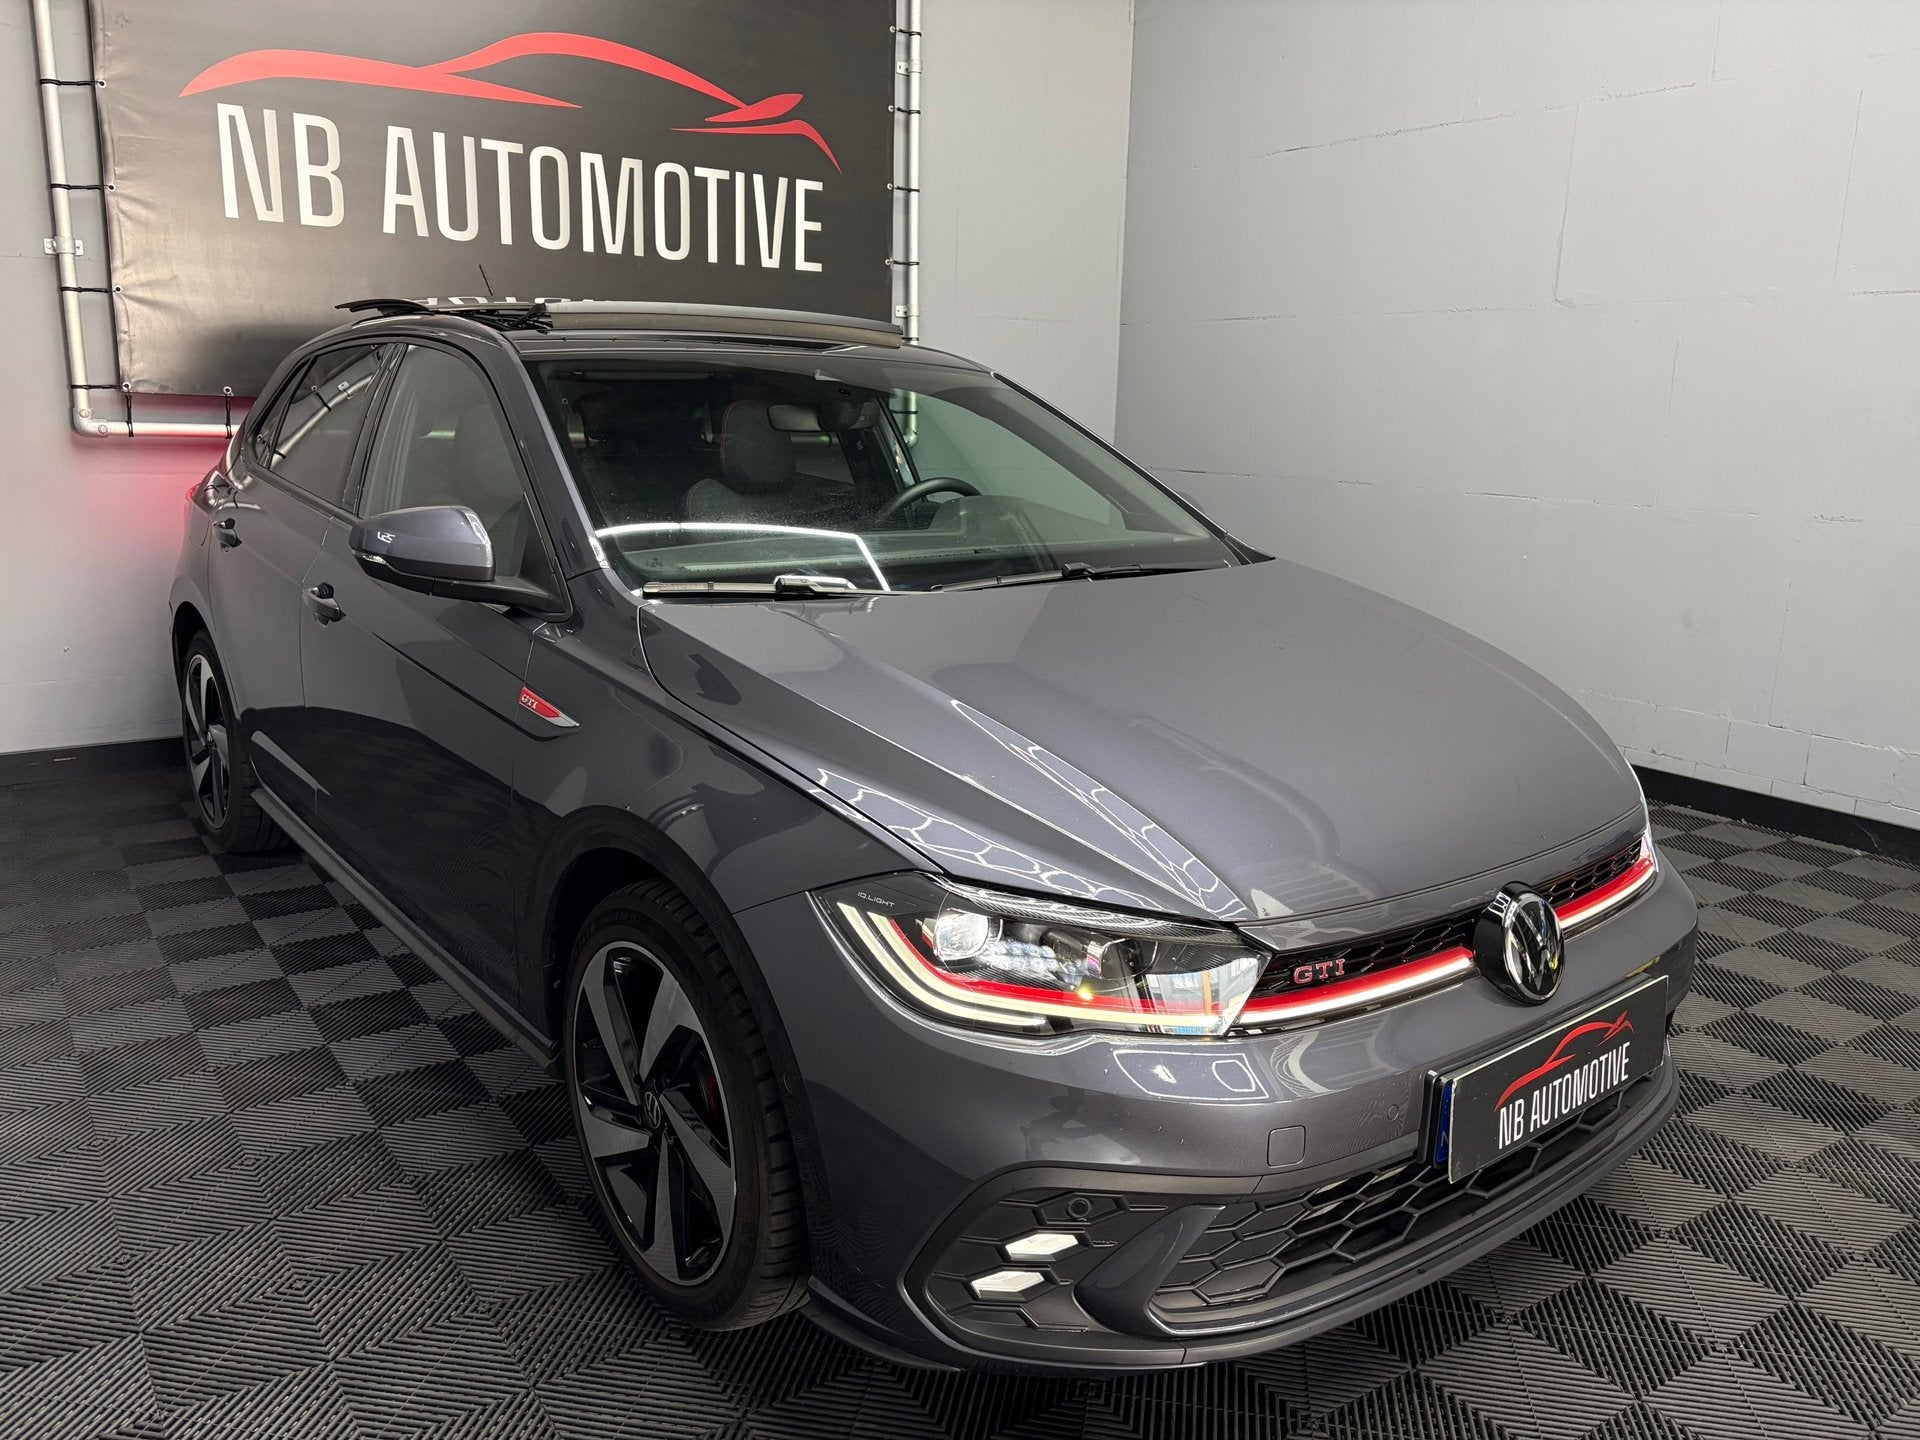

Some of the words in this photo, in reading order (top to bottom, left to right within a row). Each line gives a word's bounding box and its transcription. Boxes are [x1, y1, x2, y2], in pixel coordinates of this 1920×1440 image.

[216, 103, 345, 227] NB
[382, 126, 823, 272] AUTOMOTIVE
[521, 694, 538, 709] GTI
[857, 891, 896, 907] IQ.LIGHT
[1293, 958, 1346, 984] GTI
[1498, 1098, 1525, 1150] NB
[1529, 1041, 1631, 1133] AUTOMOTIVE
